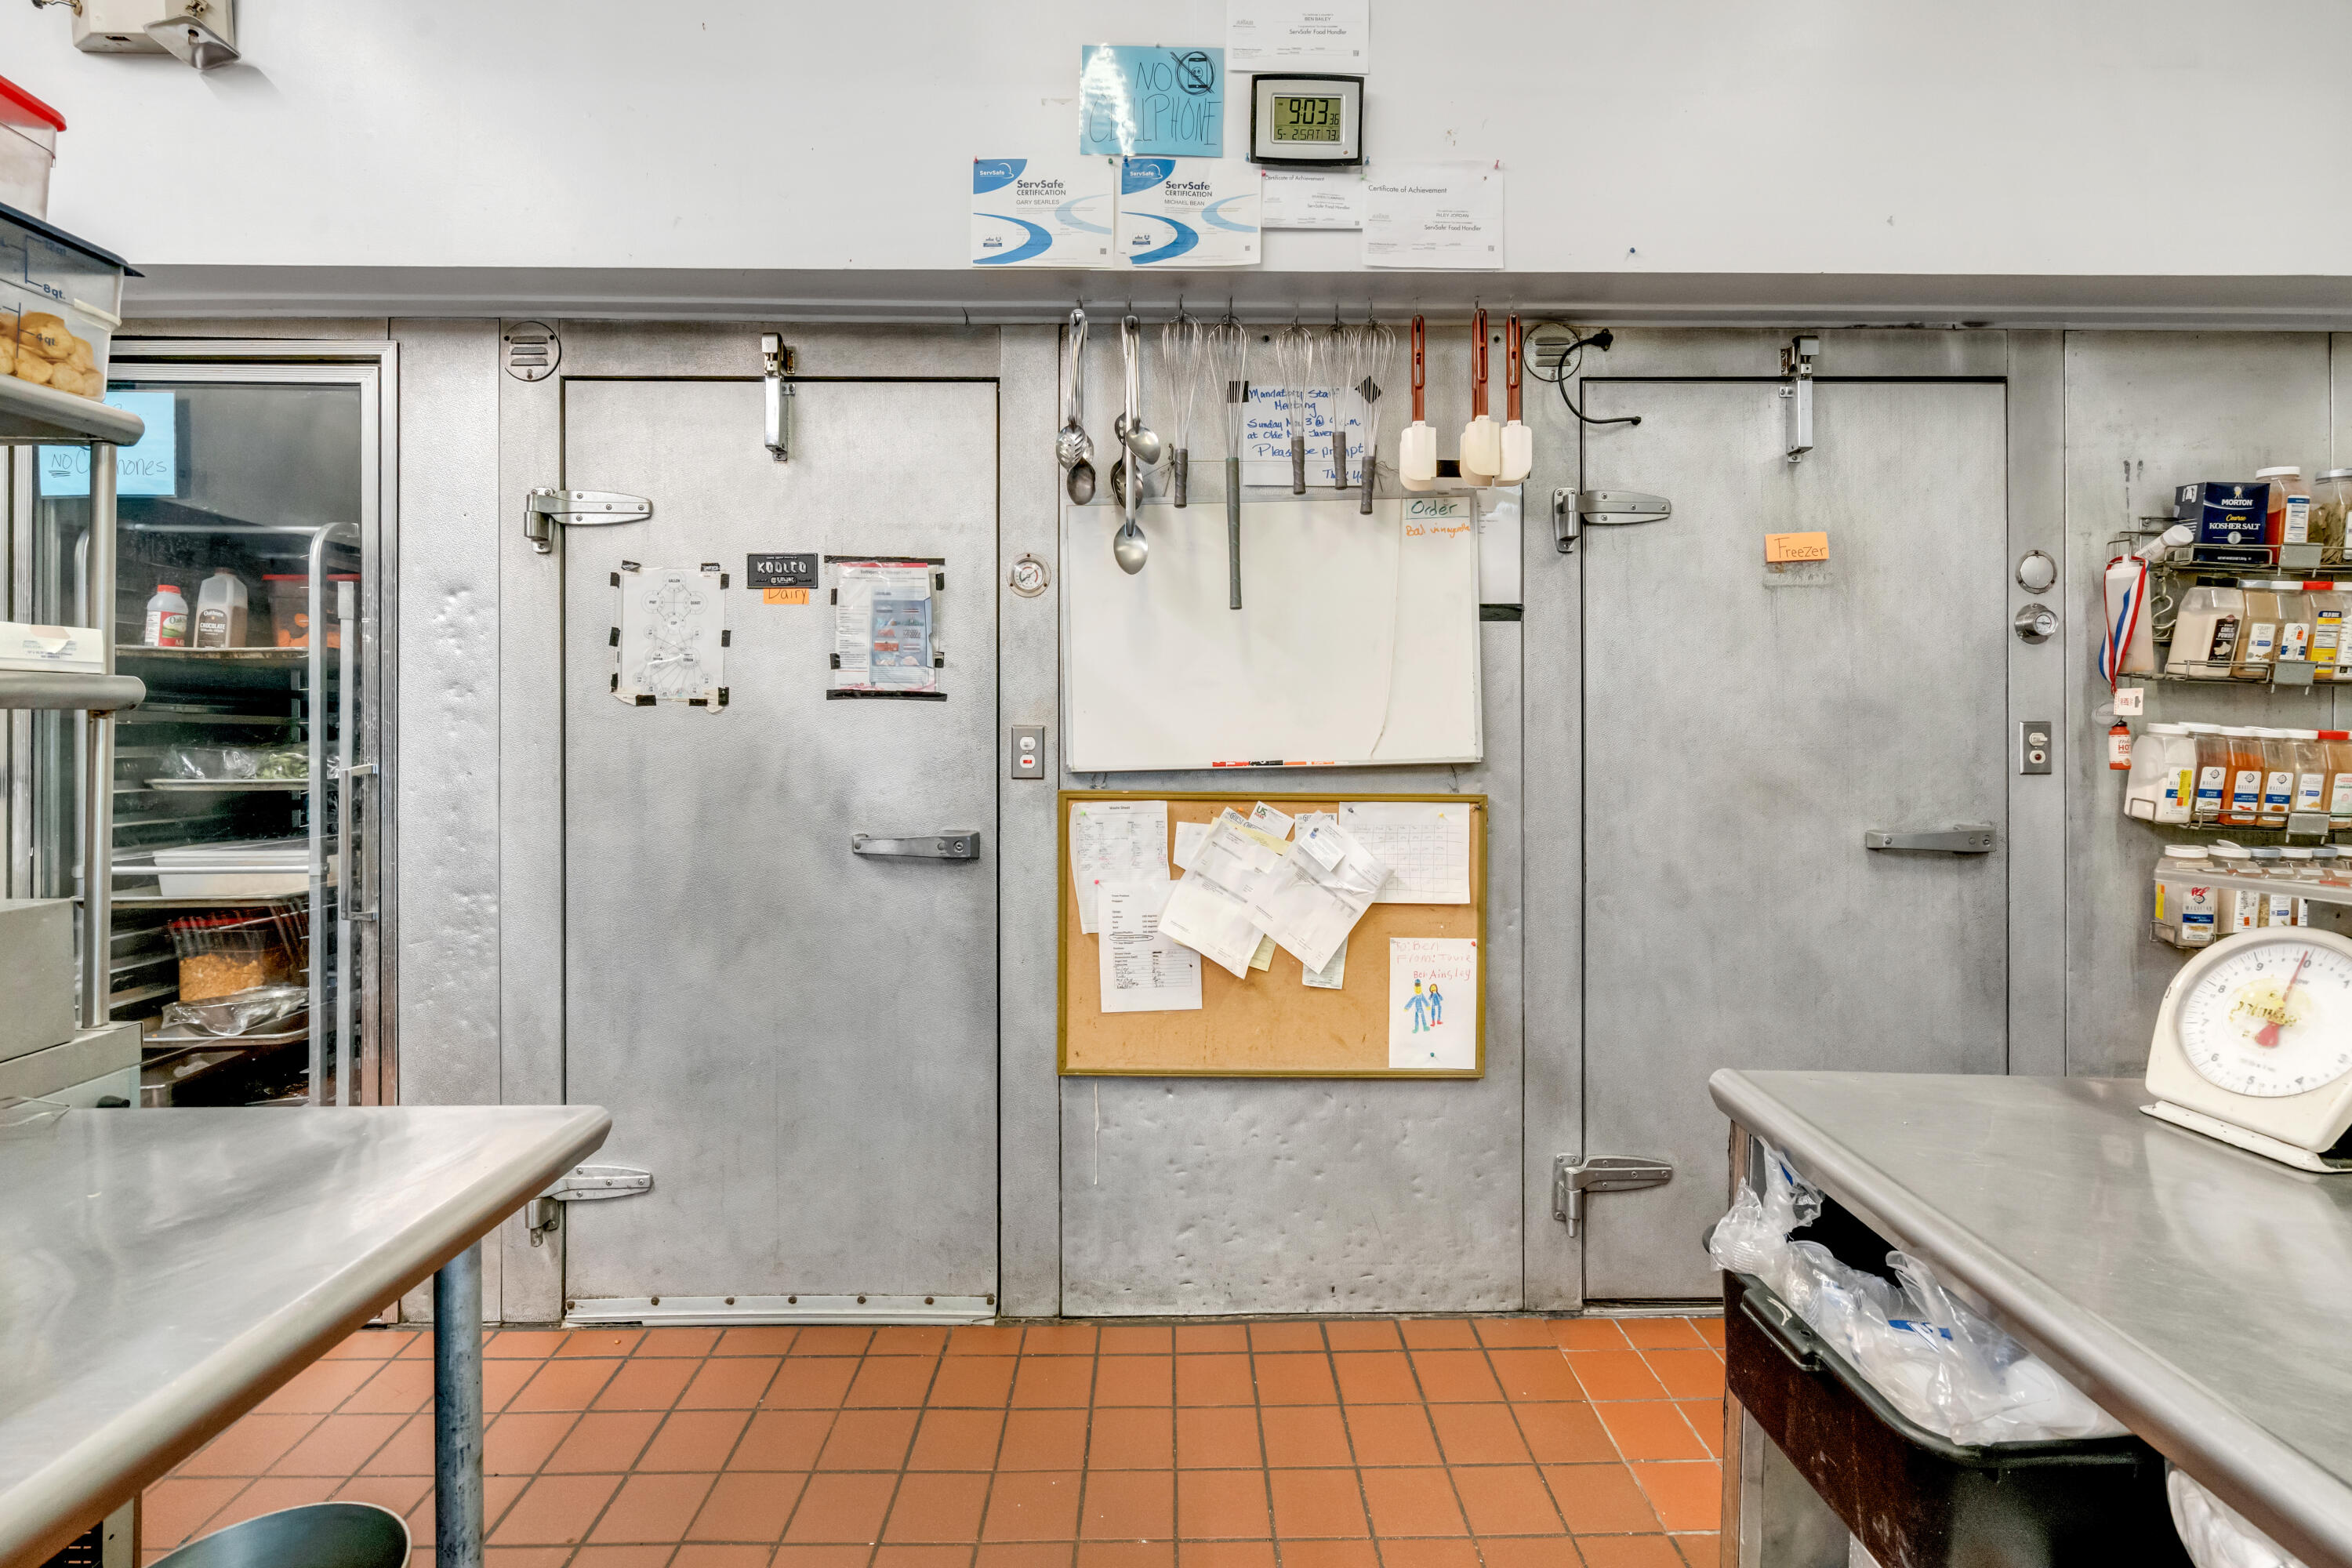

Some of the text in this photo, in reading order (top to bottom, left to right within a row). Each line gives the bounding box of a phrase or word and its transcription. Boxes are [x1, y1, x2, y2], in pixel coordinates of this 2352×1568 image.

[1136, 62, 1173, 92] NO
[1300, 129, 1321, 140] SAT
[1408, 186, 1447, 194] Achievement
[1247, 418, 1283, 432] Sunday
[1253, 443, 1294, 458] Pleas
[51, 453, 72, 470] NO
[1411, 500, 1458, 517] Order
[768, 588, 808, 605] Dairy
[2256, 960, 2311, 971] 9 0
[2218, 985, 2227, 993] 8
